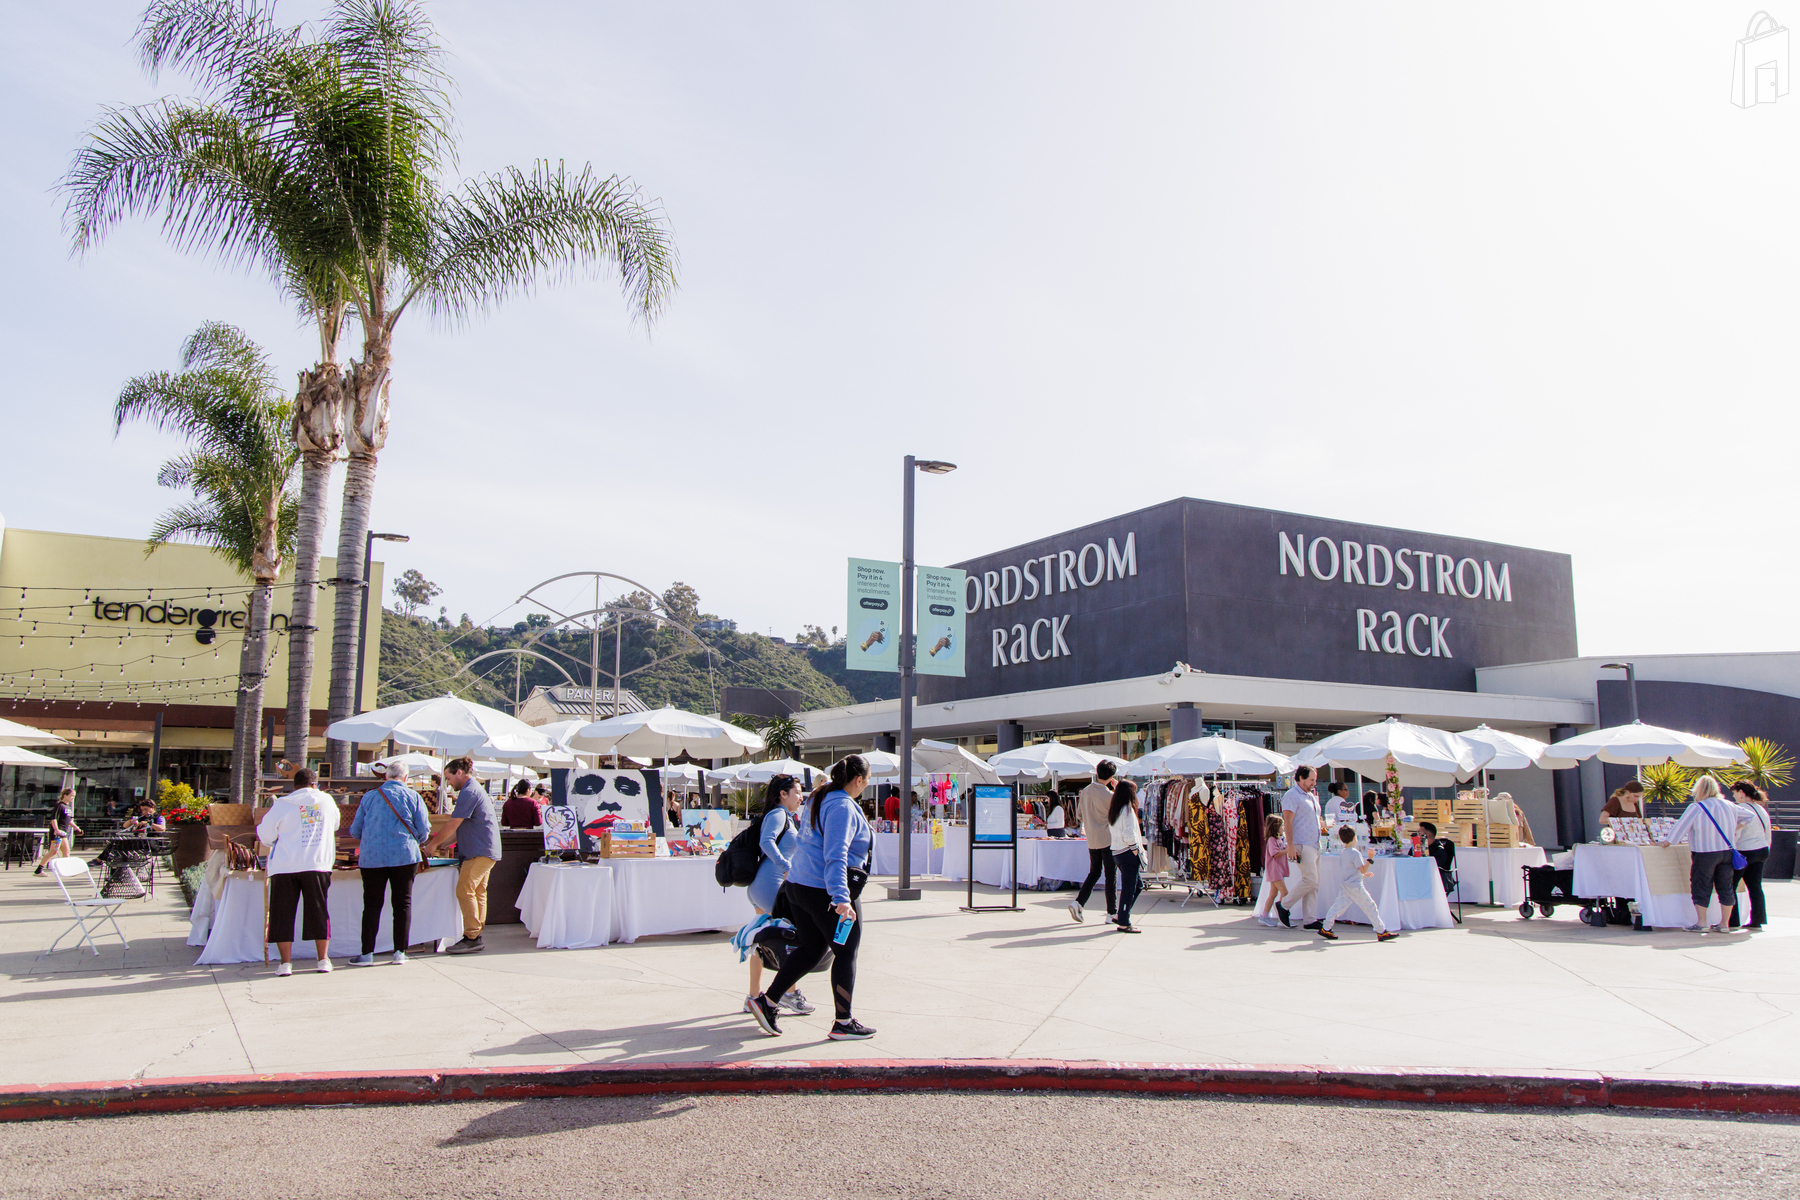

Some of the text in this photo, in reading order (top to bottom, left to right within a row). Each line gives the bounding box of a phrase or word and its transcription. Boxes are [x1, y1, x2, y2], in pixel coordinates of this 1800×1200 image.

[1278, 531, 1512, 602] NORDSTROM
[926, 573, 939, 581] Shop
[965, 532, 1137, 613] ORDSTROM
[857, 580, 891, 589] interest-free
[926, 580, 937, 588] Pay
[857, 587, 891, 596] installments.
[92, 596, 293, 645] tendergren
[1152, 1062, 1255, 1070] PARKING
